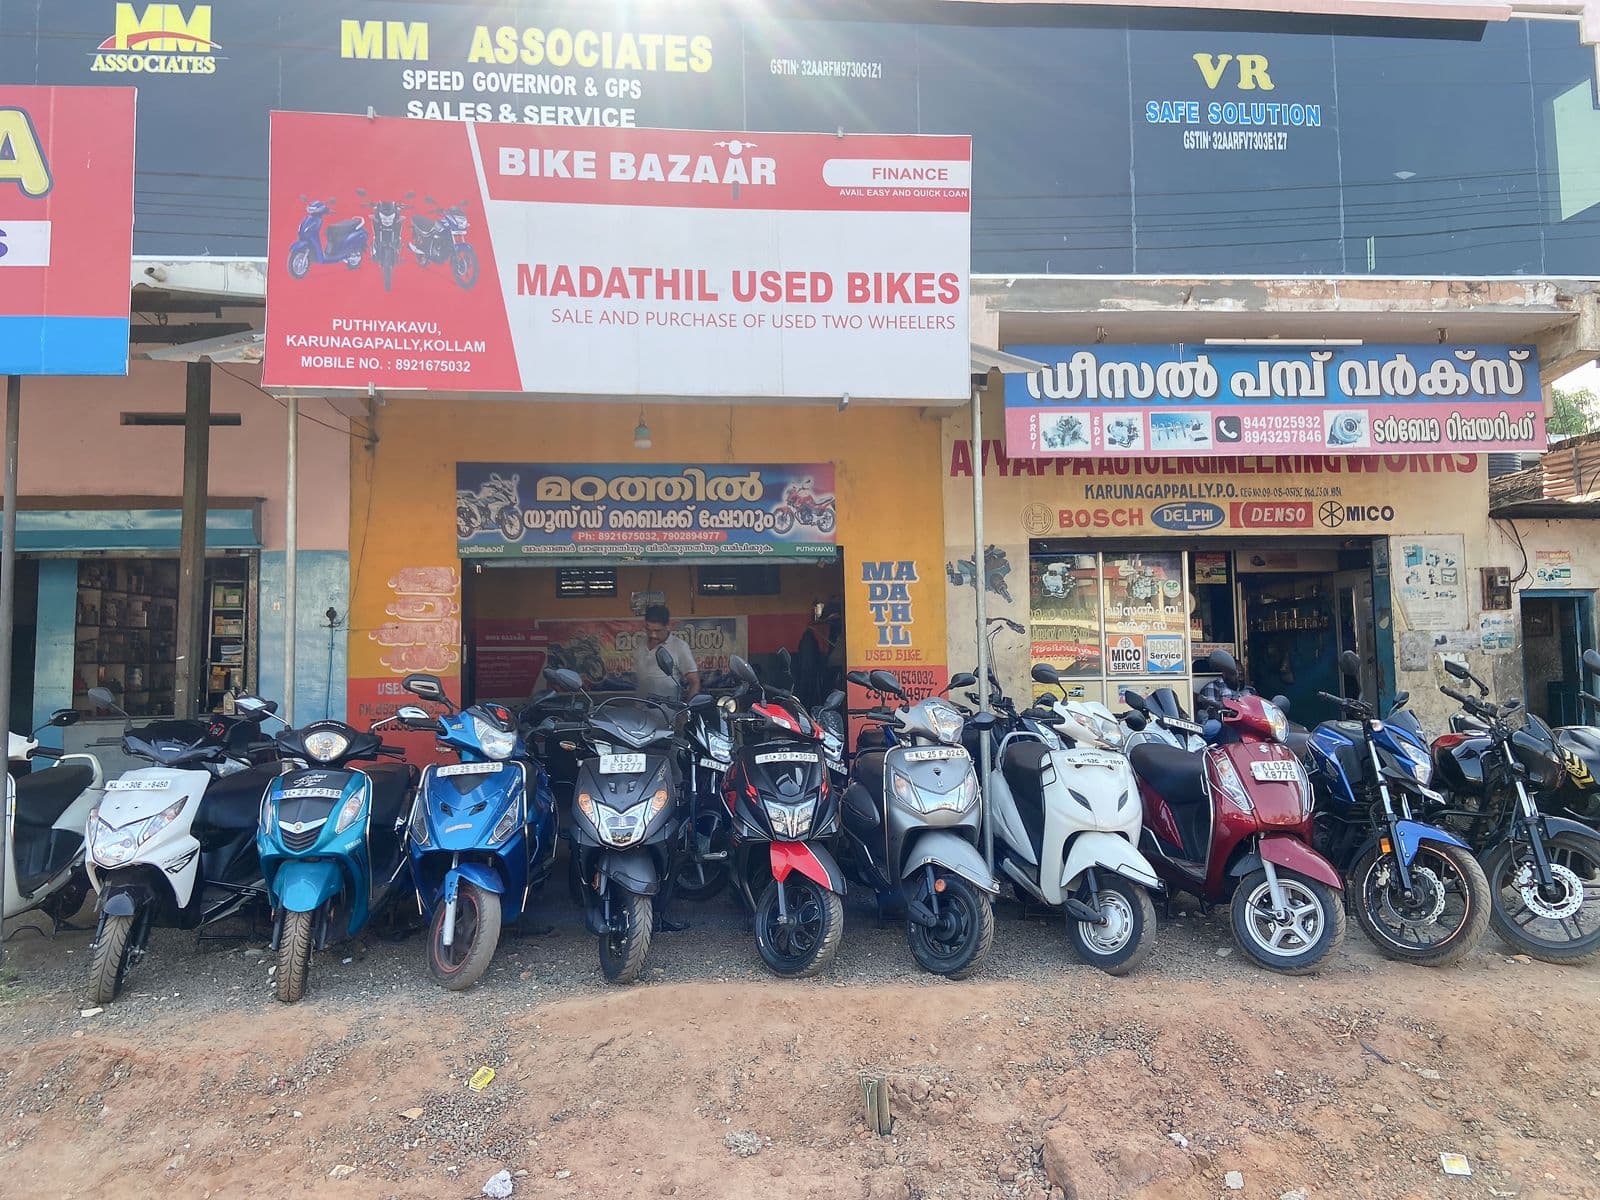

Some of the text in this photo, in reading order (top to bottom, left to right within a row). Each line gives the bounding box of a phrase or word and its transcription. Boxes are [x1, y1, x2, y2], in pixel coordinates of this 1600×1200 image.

[116, 3, 211, 52] MM
[341, 20, 712, 73] MM ASSOCIATES
[90, 54, 216, 74] ASSOCIATES
[402, 70, 642, 99] SPEED GOVERNOR & GPS
[406, 100, 636, 127] SALES & SERVICE
[1146, 100, 1321, 127] SAFE SOLUTION
[499, 147, 776, 185] BIKE BAZAAR
[872, 168, 948, 181] FINANCE
[839, 189, 864, 197] AVAIL
[867, 189, 890, 197] EASY
[913, 190, 941, 198] QUICK
[943, 190, 967, 198] LOAN
[517, 263, 960, 304] MADATHIL USED BIKES
[332, 319, 441, 336] PUTHIYAKAVU,
[551, 308, 955, 330] SALE AND PURCHASE OF USED TWO WHEELERS
[286, 335, 486, 353] KARUNAGAPALLY,KOLLAM
[301, 356, 354, 369] MOBILE
[359, 357, 383, 370] NO.
[396, 359, 471, 373] 8921675032
[1027, 351, 1217, 399] ഡീസൽ
[1230, 351, 1333, 397] പമ്പ്
[1243, 416, 1321, 429] 9447025932
[1373, 415, 1441, 443] ടർബോ
[1244, 430, 1322, 443] 8943297846
[608, 505, 696, 529] ബൈക്ക്
[1058, 508, 1144, 529] BOSCH
[1163, 510, 1213, 523] DELPHI
[1251, 506, 1306, 523] DENSO
[1346, 505, 1395, 521] MICO
[578, 532, 720, 542] Ph: 8921675032, 7902894977
[1150, 640, 1183, 652] BOSCH
[865, 650, 922, 661] USED BIKE
[1112, 649, 1141, 662] MICO
[1150, 652, 1181, 660] Service
[1113, 662, 1141, 670] SERVICE
